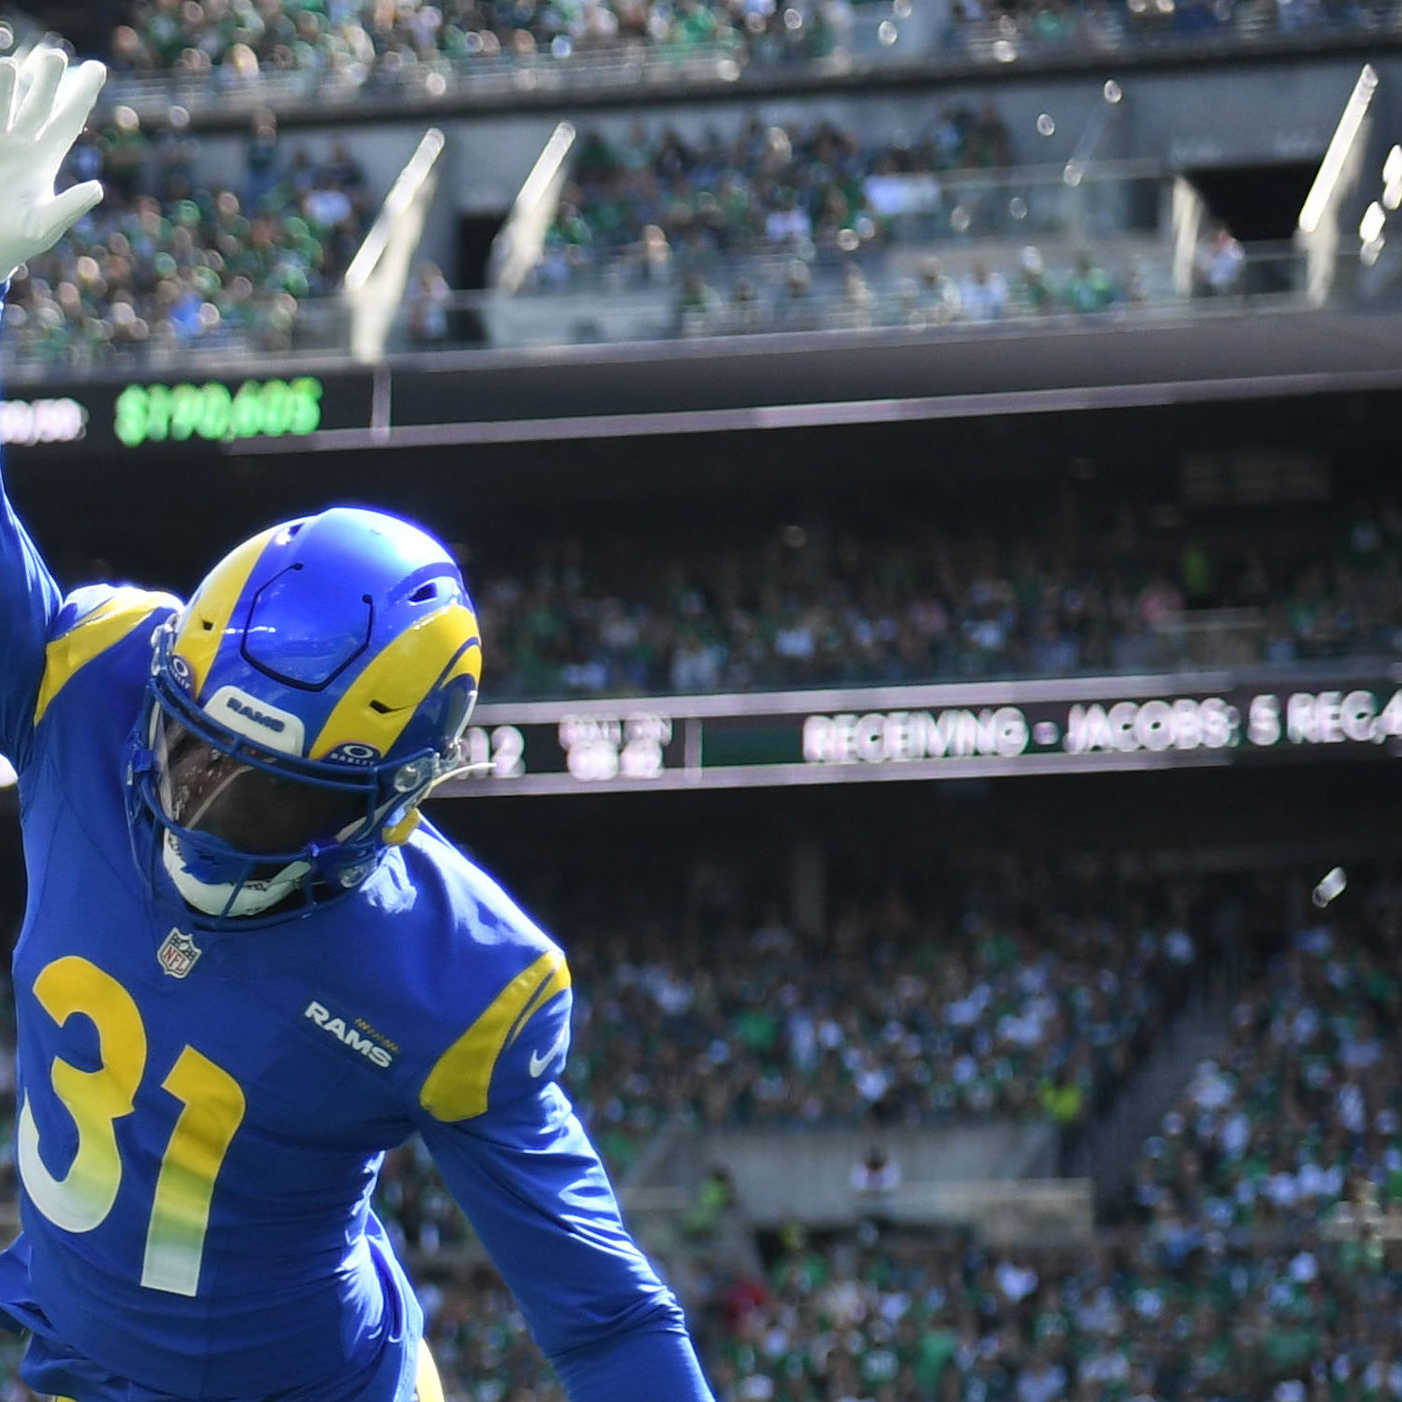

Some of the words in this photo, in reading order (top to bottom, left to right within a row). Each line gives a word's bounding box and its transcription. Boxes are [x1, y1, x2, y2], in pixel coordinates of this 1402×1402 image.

[226, 697, 285, 733] RAMS
[802, 706, 1029, 764] RECEIVING
[304, 1001, 393, 1068] RAMS
[18, 955, 247, 1297] 31
